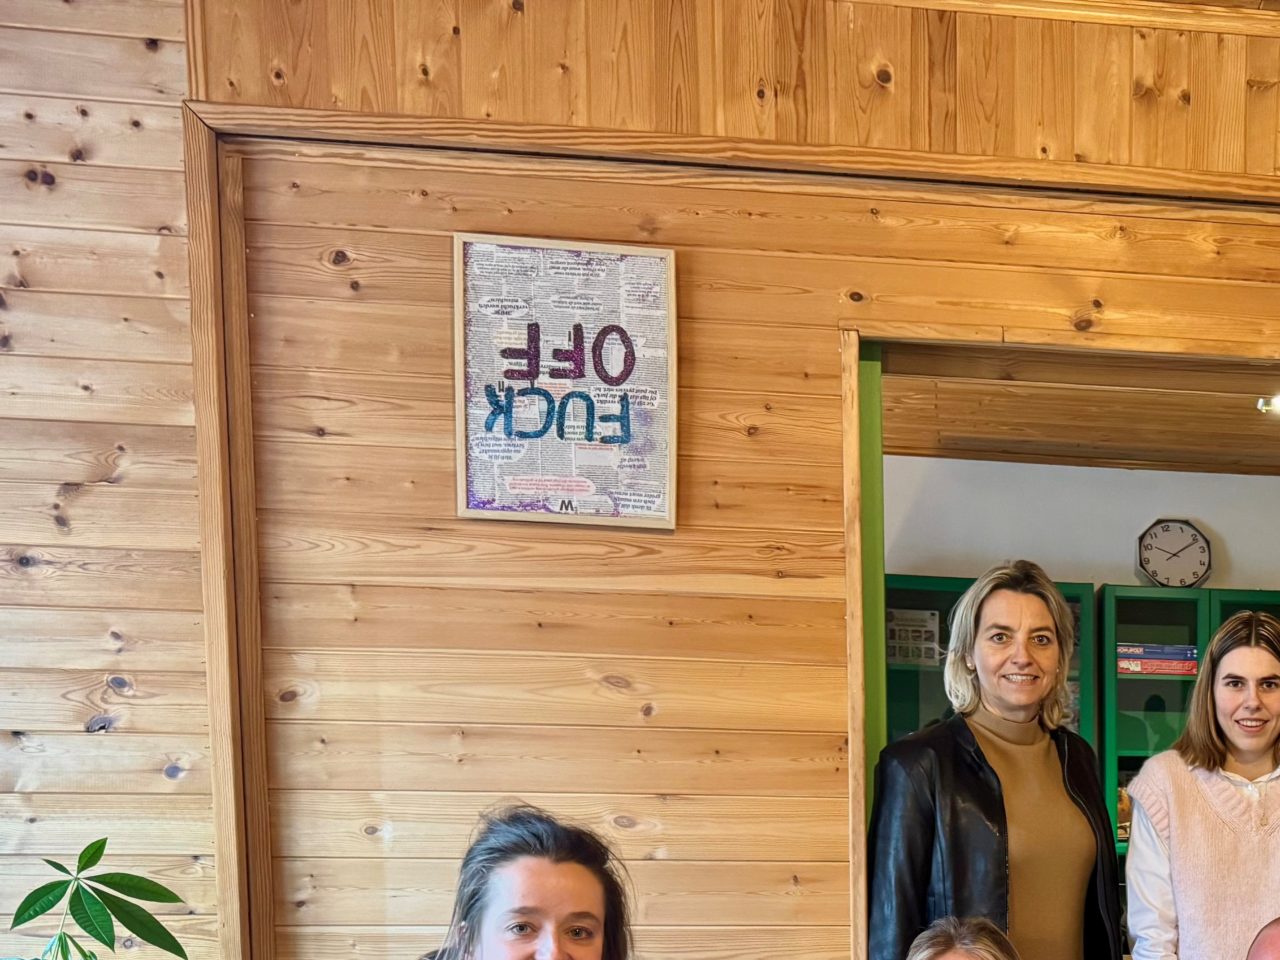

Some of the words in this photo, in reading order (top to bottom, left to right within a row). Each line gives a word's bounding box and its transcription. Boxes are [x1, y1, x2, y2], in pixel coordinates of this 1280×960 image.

[499, 322, 636, 387] OFF
[484, 384, 631, 445] FUCK
[559, 499, 574, 512] W
[1160, 524, 1170, 533] 12
[1148, 531, 1158, 540] 11
[1191, 533, 1199, 542] 2
[1143, 543, 1153, 551] 10
[1199, 545, 1206, 554] 3
[1143, 557, 1150, 565] 9
[1151, 570, 1158, 578] 8
[1192, 571, 1199, 579] 5
[1164, 577, 1170, 585] 7
[1179, 578, 1187, 586] 6
